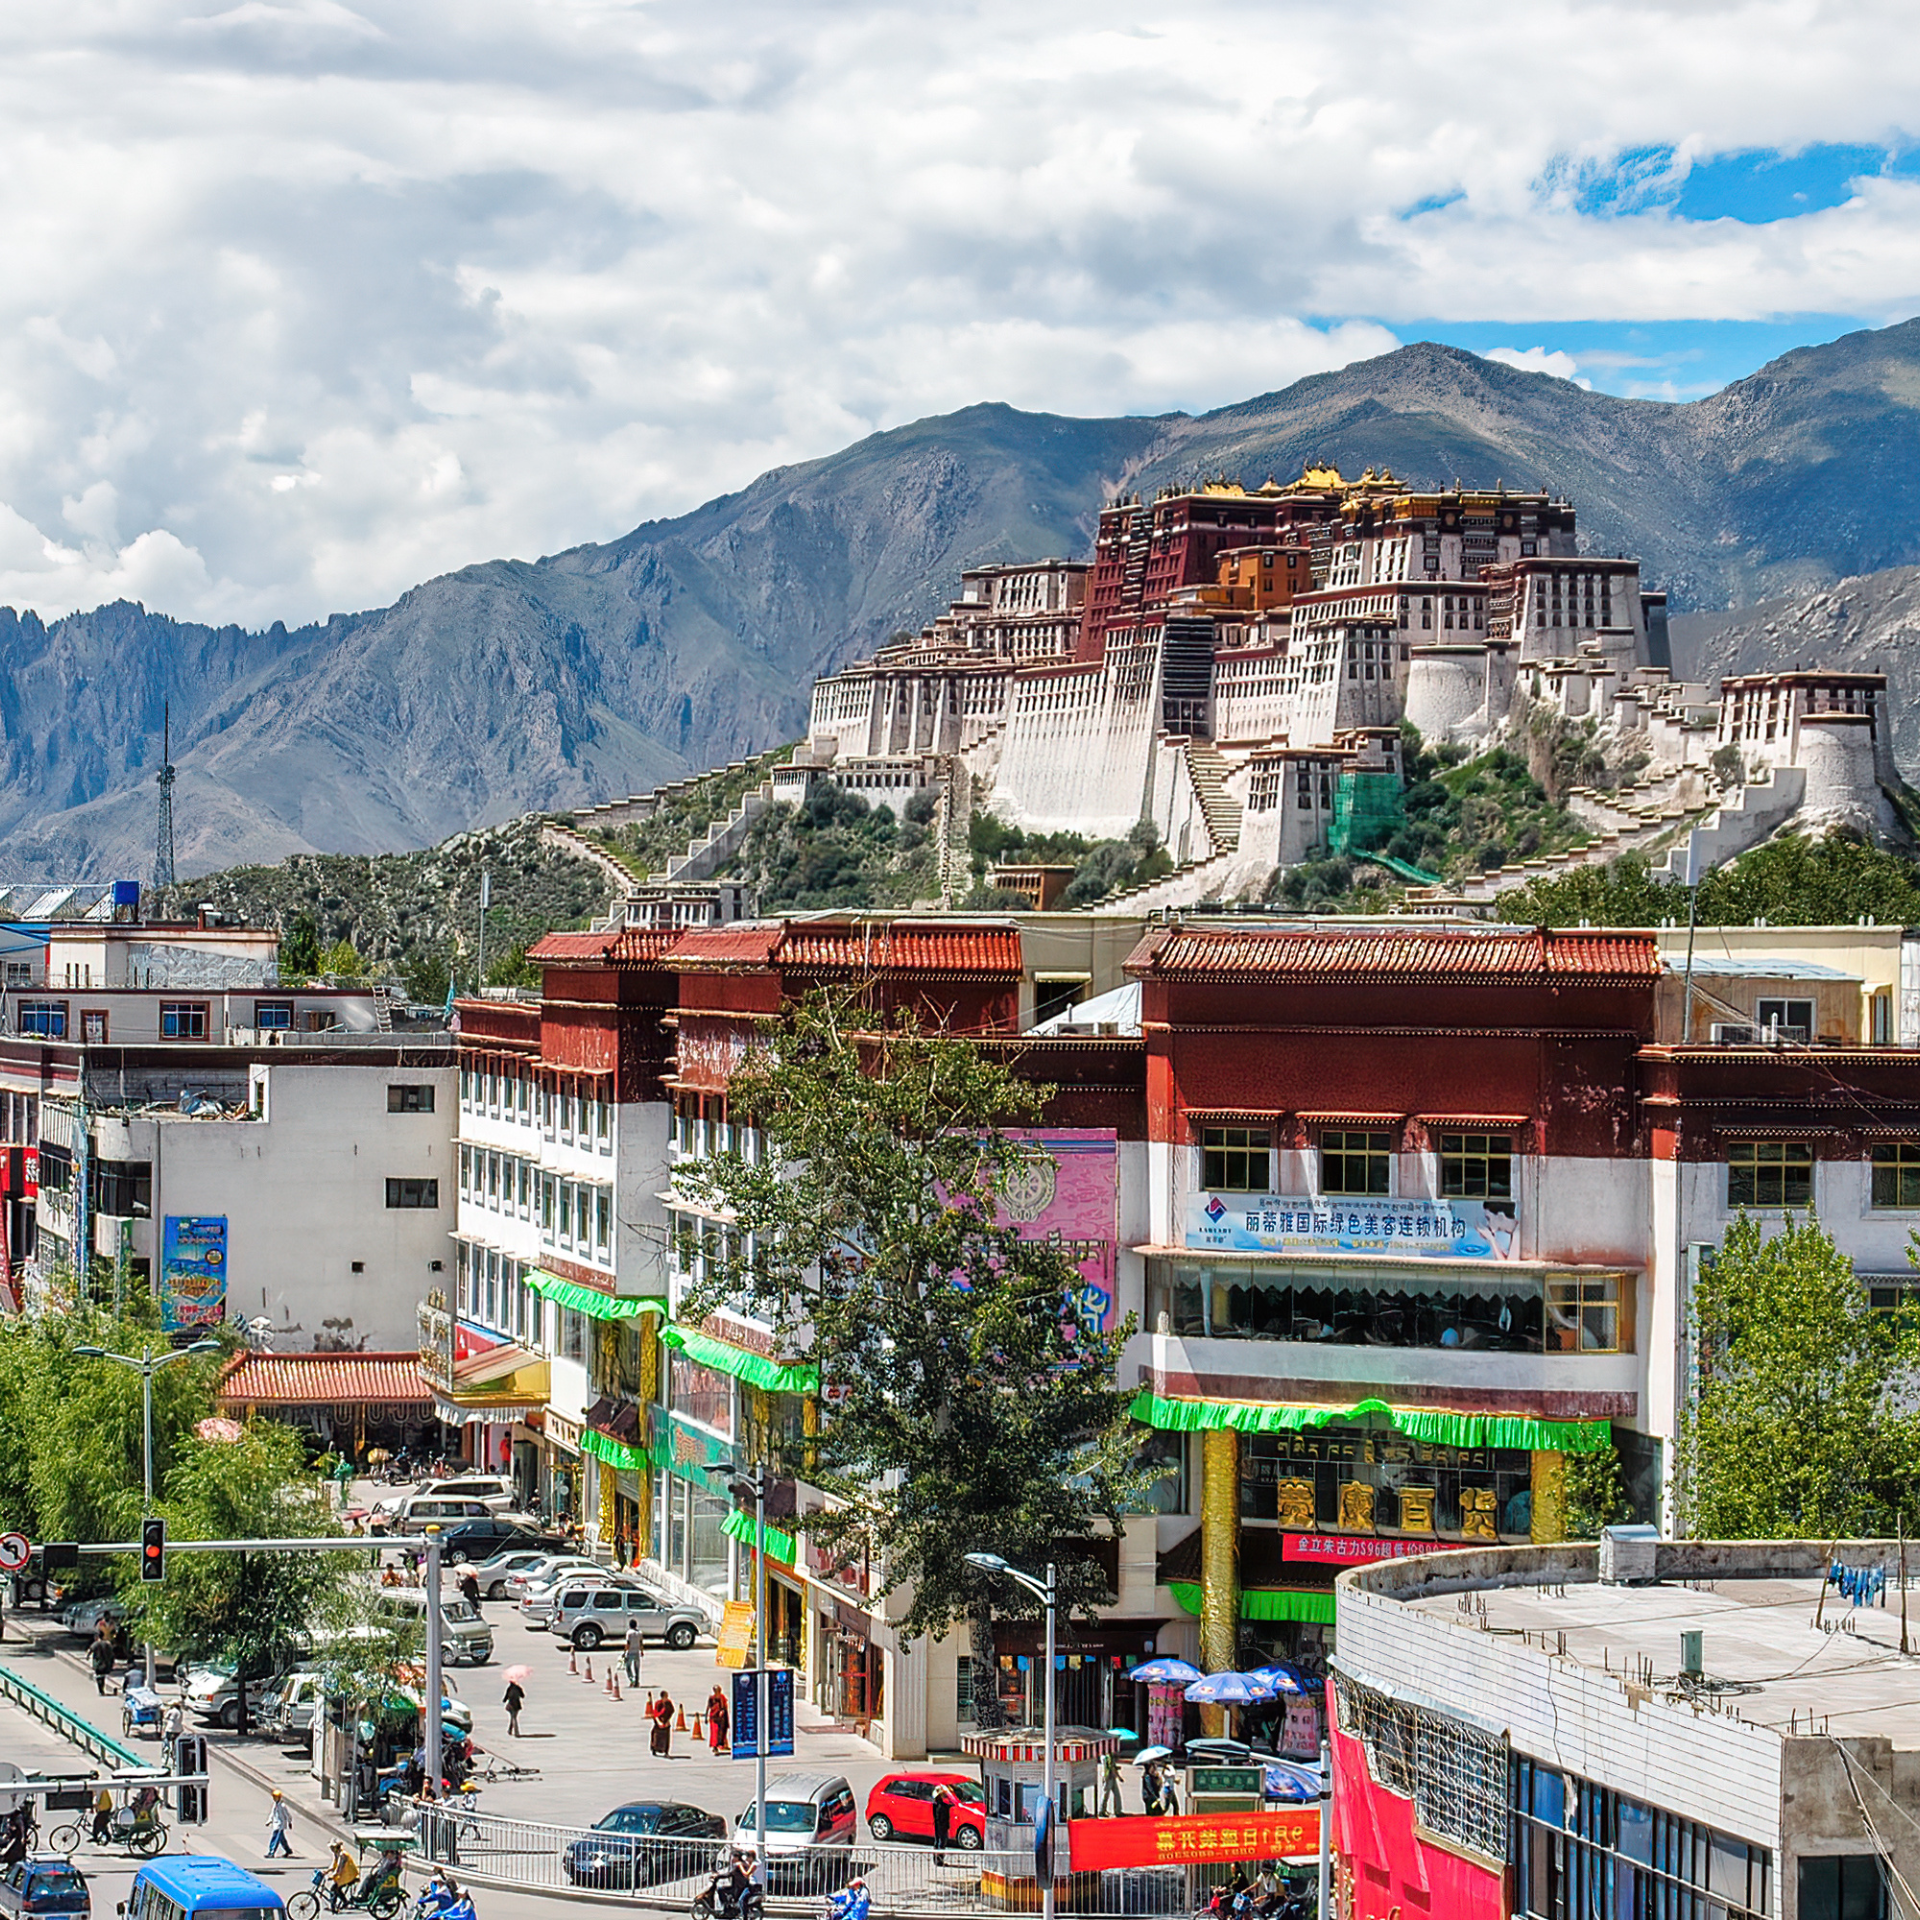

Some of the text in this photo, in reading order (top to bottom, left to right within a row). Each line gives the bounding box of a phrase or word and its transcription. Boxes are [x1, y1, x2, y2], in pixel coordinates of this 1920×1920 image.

[1245, 1211, 1467, 1239] 丽蒂雅国际绿色美容连锁机构
